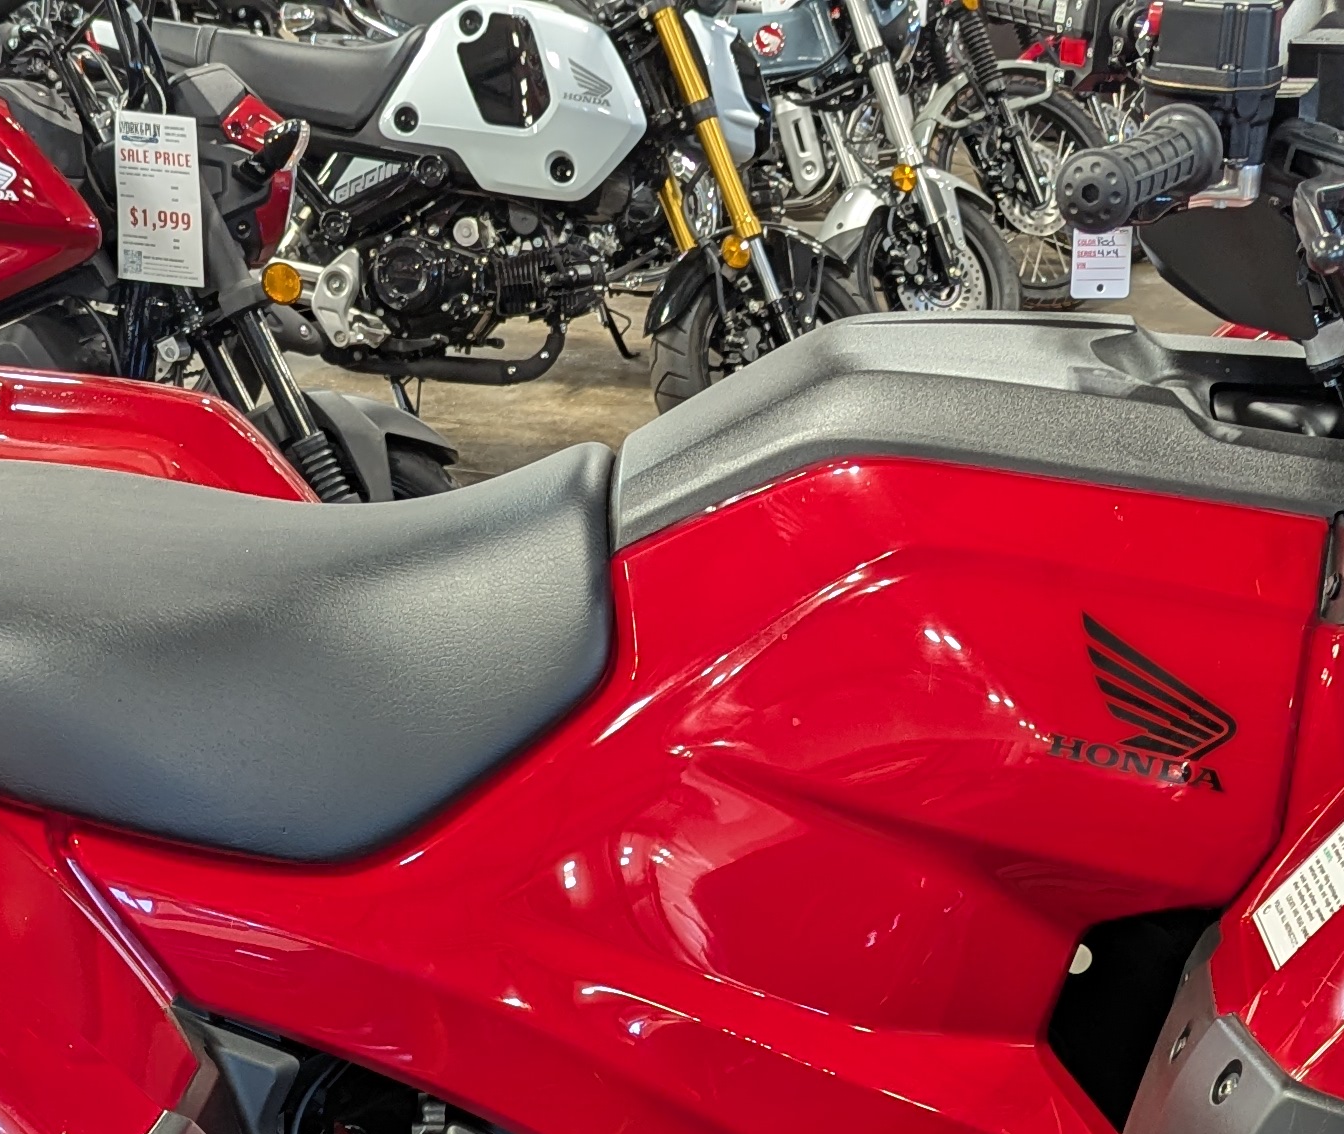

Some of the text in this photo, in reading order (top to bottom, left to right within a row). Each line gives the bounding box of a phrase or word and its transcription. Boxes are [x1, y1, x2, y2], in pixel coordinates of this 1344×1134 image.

[563, 92, 611, 107] HONDA
[120, 148, 192, 168] SALE PRICE
[130, 206, 191, 231] $1,999
[1047, 733, 1224, 793] HONDA
